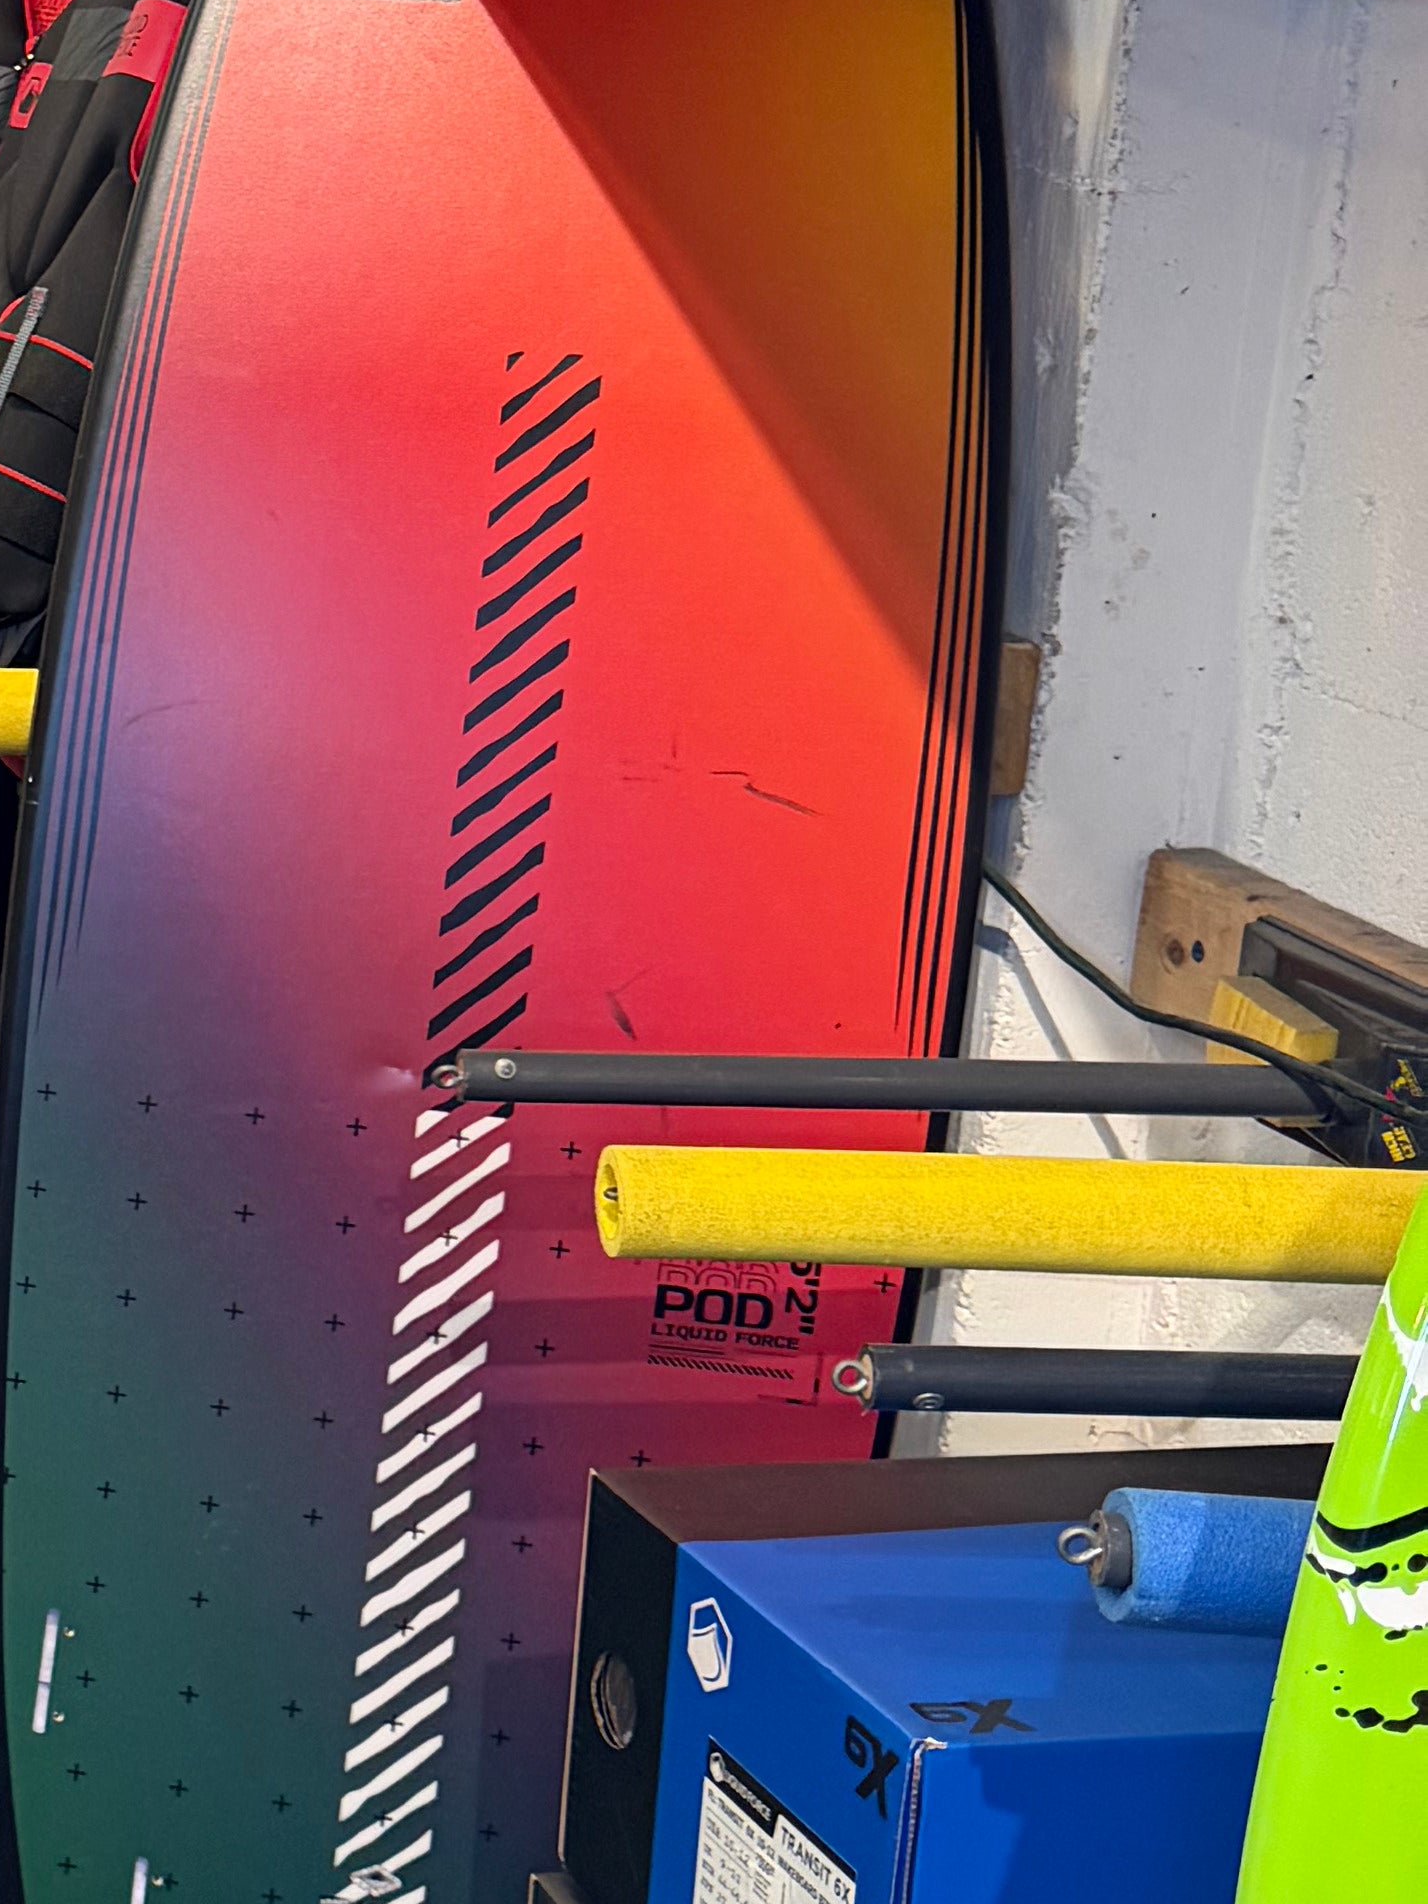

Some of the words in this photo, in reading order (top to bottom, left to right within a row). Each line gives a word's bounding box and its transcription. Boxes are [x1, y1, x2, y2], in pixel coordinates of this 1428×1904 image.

[653, 1283, 773, 1329] POD
[650, 1322, 728, 1343] LIQUID
[735, 1331, 800, 1351] FORCE
[910, 1699, 1038, 1733] 6X
[844, 1715, 899, 1819] 6X
[780, 1825, 831, 1890] TRANSIT
